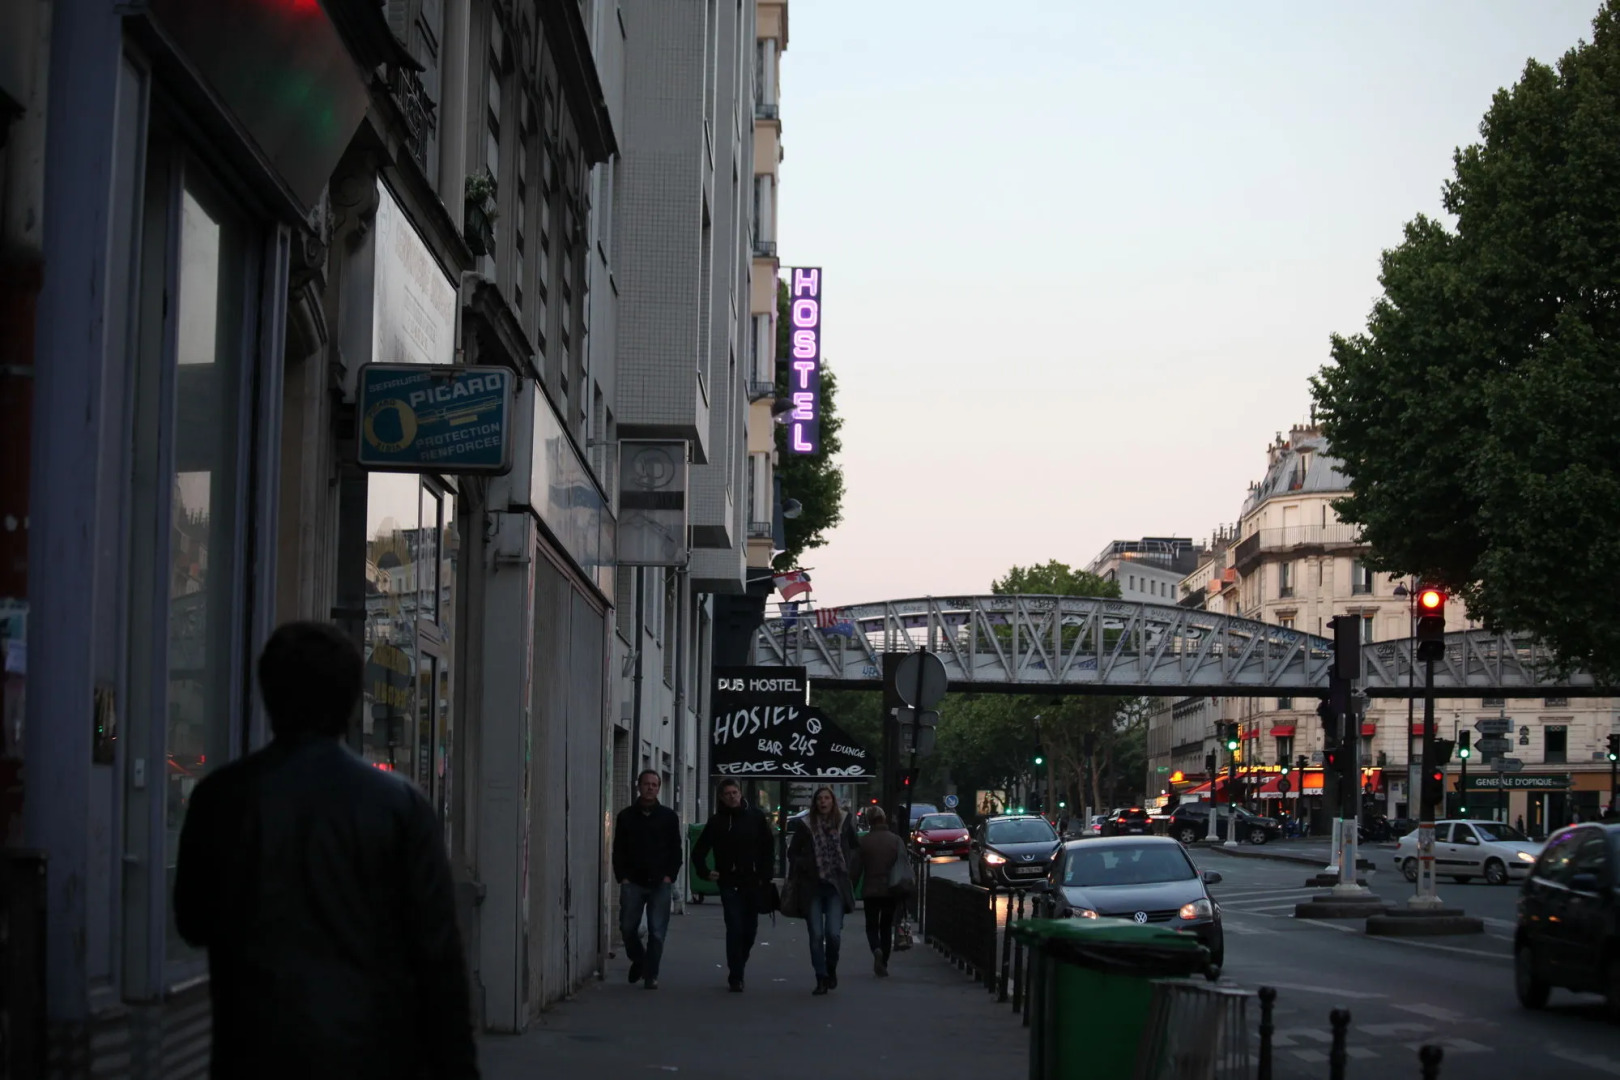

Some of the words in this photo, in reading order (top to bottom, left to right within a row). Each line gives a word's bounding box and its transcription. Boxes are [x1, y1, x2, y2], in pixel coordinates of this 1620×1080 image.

[793, 268, 818, 452] HOSTEL
[409, 374, 502, 408] PICARD
[415, 422, 501, 449] PROTECTION
[749, 678, 803, 692] HOSTEL
[757, 738, 783, 757] BAR
[788, 732, 818, 757] 245
[830, 743, 866, 759] LOUNGE
[716, 760, 779, 775] PEACE
[1514, 778, 1553, 787] D'OPTIQUE
